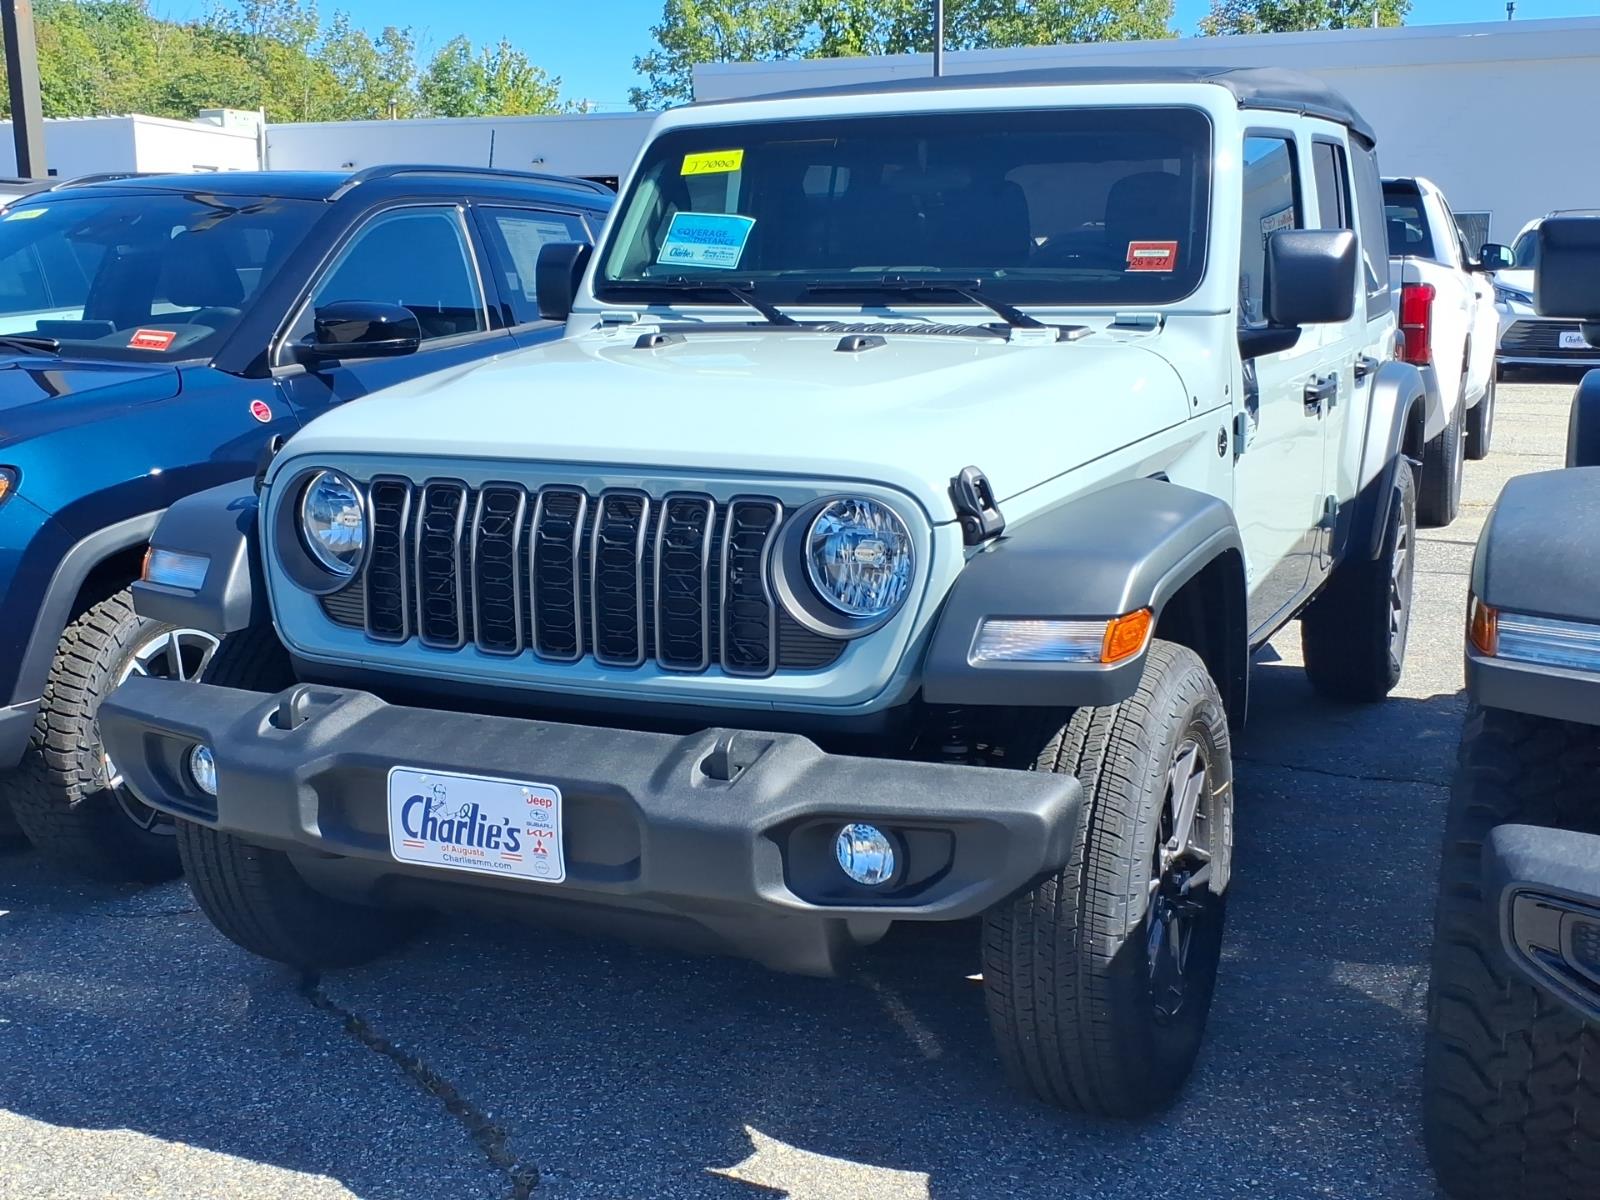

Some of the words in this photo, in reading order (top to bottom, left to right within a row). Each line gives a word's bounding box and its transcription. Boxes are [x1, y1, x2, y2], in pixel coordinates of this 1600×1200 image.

[676, 227, 729, 238] COVERAGE
[1131, 257, 1144, 266] 26
[1155, 257, 1168, 266] 27
[526, 794, 553, 809] Jeep
[401, 794, 521, 853] Charlie's
[526, 821, 553, 829] SUBARU
[441, 844, 450, 852] of
[451, 845, 485, 857] Augusta
[442, 853, 512, 870] Charliesmm.com
